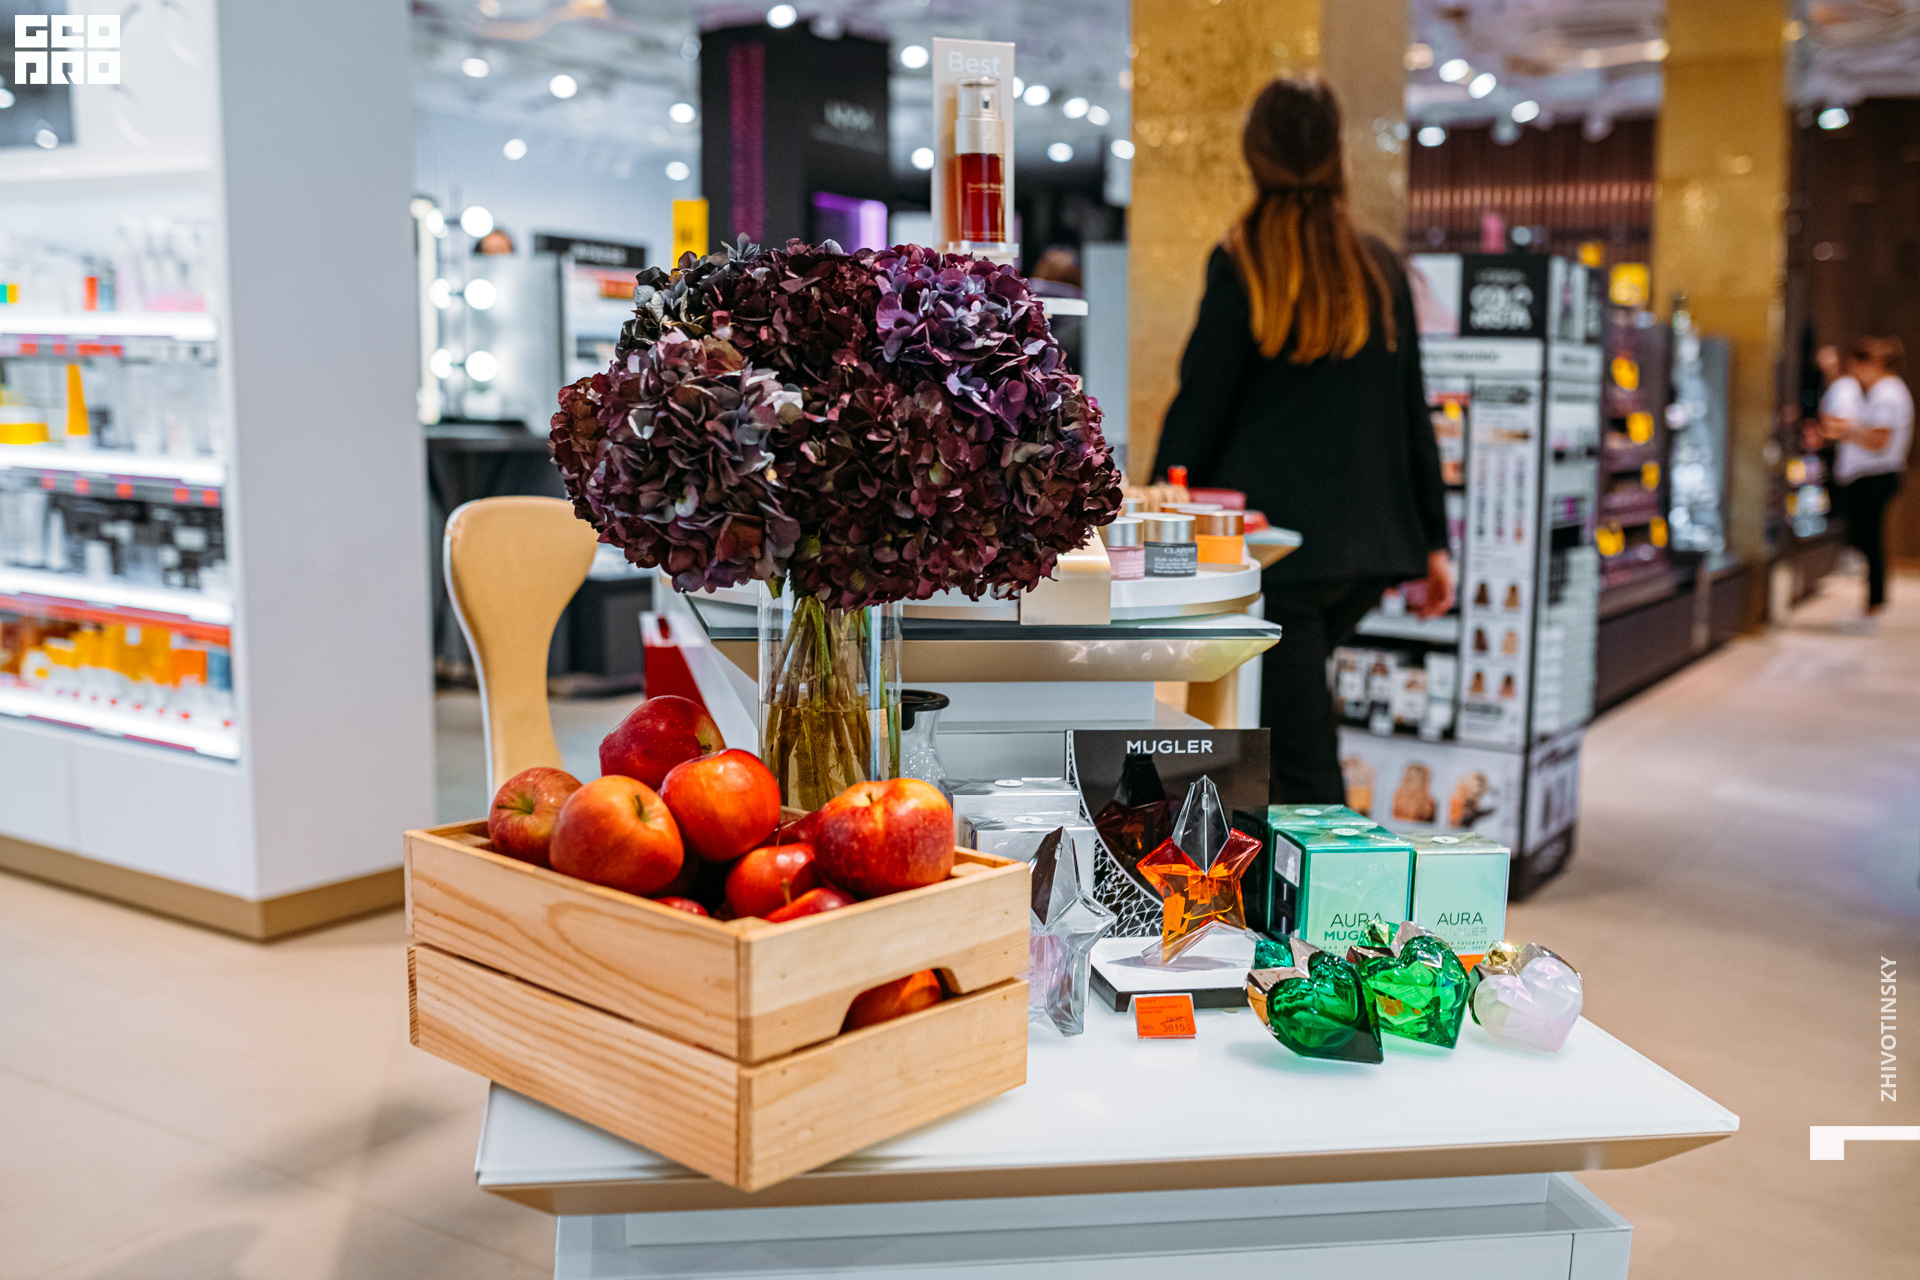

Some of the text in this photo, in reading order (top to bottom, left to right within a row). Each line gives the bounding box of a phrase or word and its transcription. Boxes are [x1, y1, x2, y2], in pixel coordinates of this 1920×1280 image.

[948, 51, 1001, 75] Best
[1126, 740, 1214, 754] MUGLER
[1436, 912, 1484, 926] AURA
[1324, 930, 1359, 941] MUG
[1162, 1023, 1186, 1032] 3815
